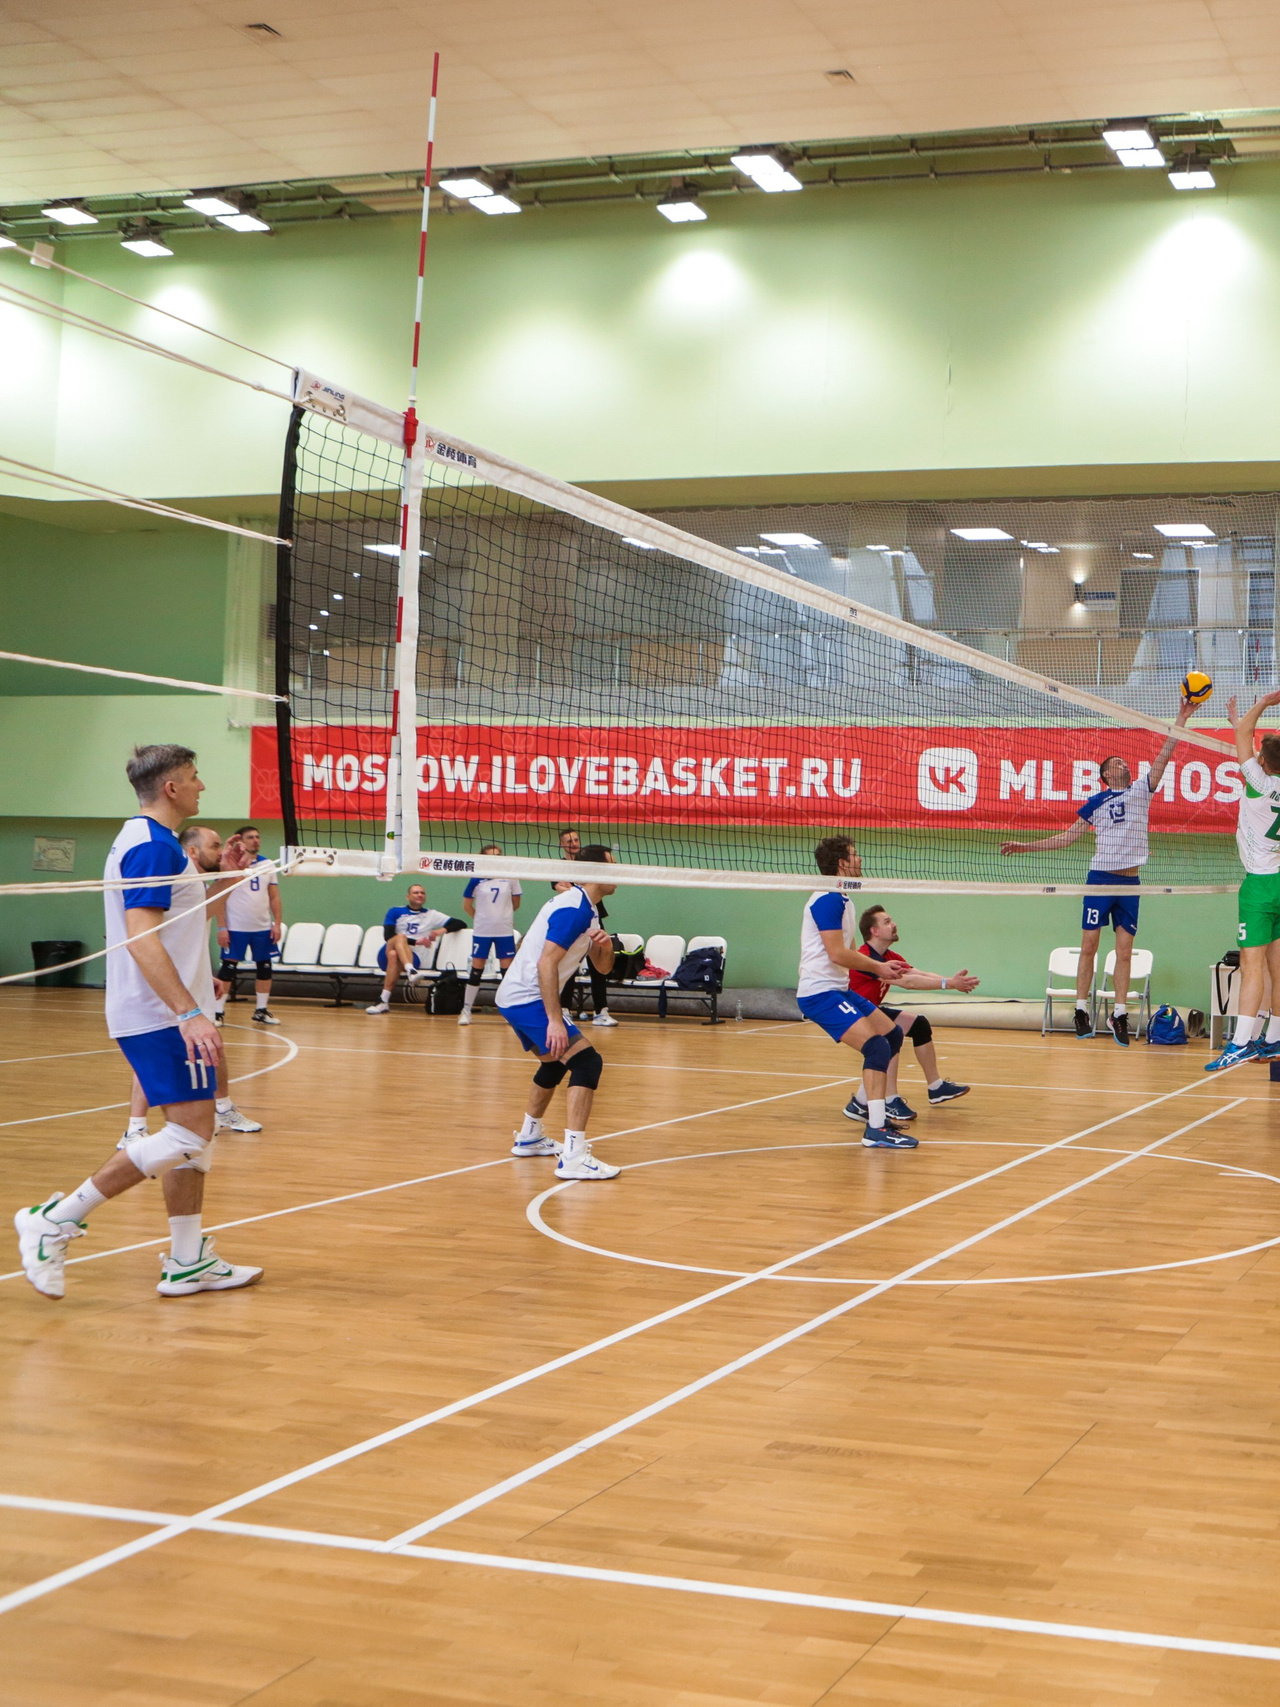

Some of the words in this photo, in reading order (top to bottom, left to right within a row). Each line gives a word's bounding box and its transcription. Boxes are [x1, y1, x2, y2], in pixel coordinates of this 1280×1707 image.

[303, 754, 862, 797] MOSOW.ILOVEBASKET.RU
[490, 888, 500, 903] 7
[1086, 908, 1099, 925] 13
[406, 922, 420, 935] 15
[473, 943, 480, 955] 7
[838, 1001, 857, 1015] 4
[185, 1059, 208, 1089] 11
